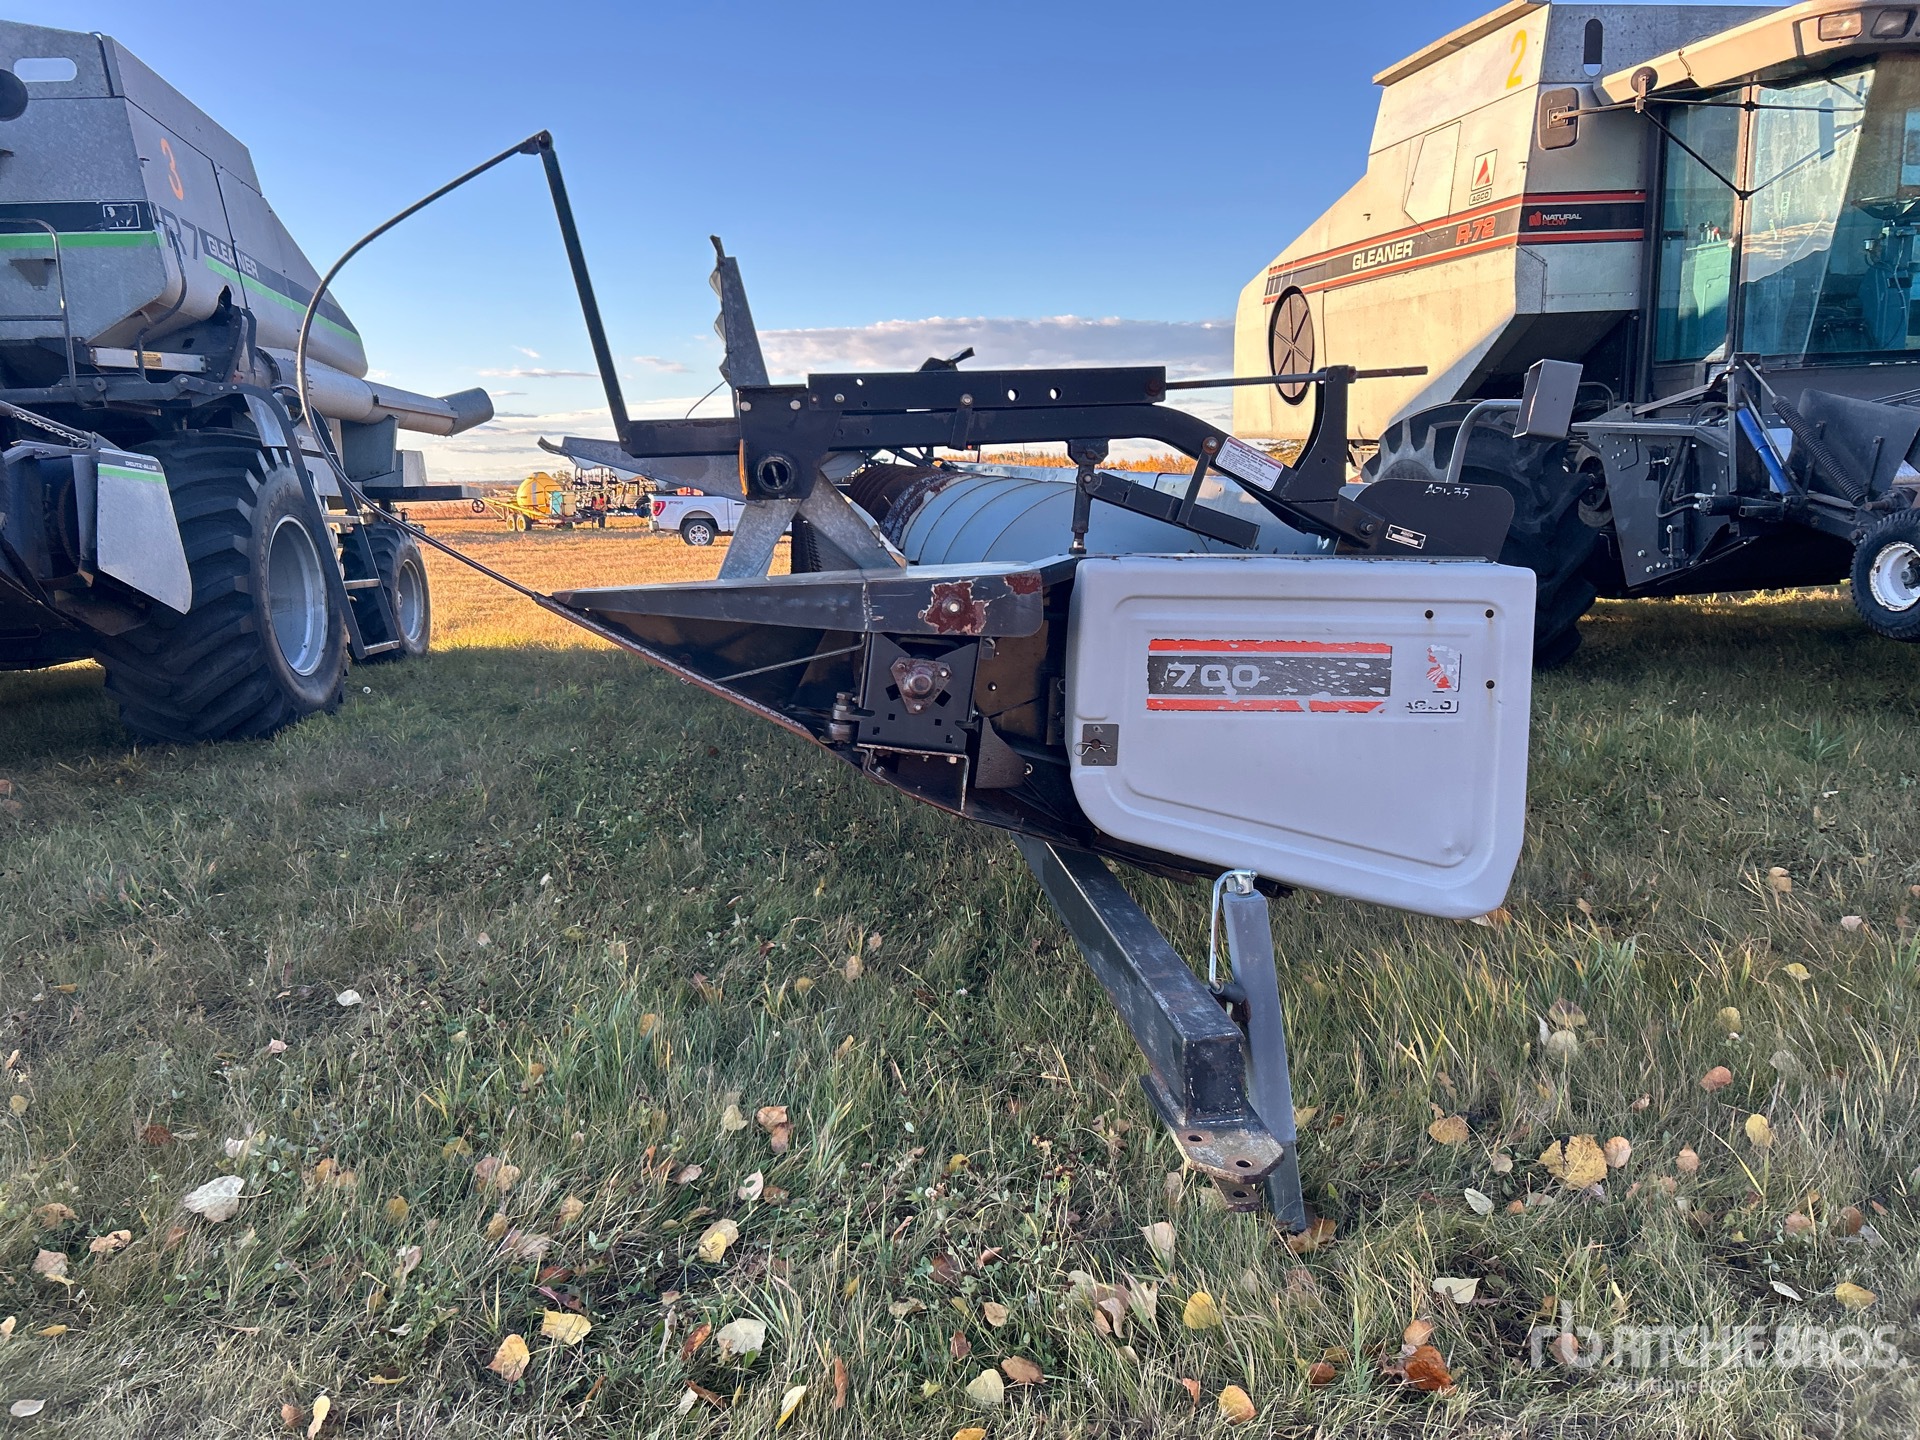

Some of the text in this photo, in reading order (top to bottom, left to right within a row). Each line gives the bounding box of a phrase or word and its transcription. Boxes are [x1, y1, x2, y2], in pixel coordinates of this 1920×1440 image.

[1506, 29, 1527, 90] 2
[160, 137, 184, 201] 3
[1471, 192, 1490, 204] AGCO
[1542, 213, 1582, 221] NATURAL
[206, 235, 259, 280] GLEANER
[1352, 240, 1414, 271] GLEANER
[1166, 662, 1261, 688] 700
